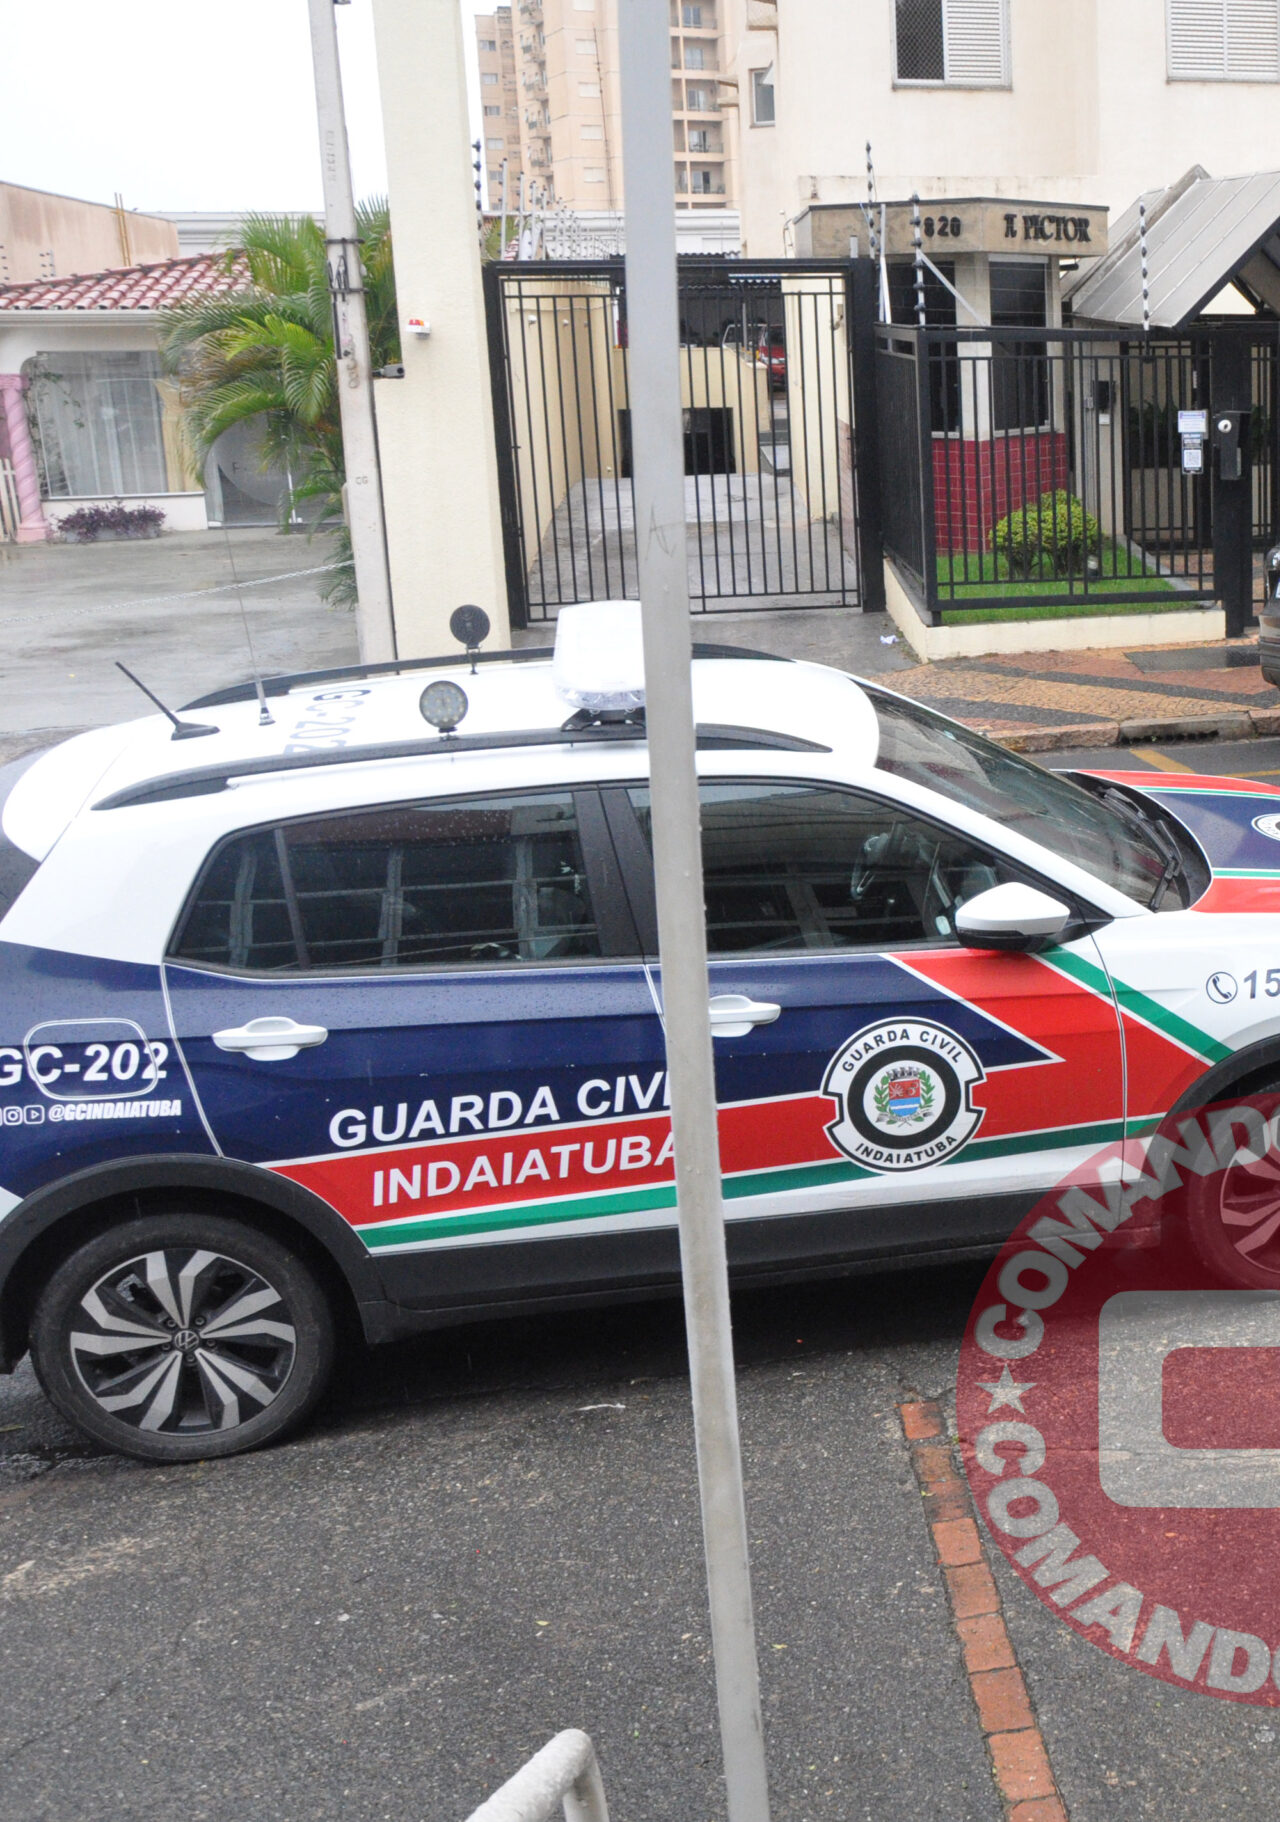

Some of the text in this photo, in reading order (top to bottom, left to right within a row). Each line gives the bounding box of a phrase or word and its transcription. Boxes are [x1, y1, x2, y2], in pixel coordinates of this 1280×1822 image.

[923, 215, 962, 238] 820
[1022, 214, 1092, 243] PICTOR
[0, 1041, 169, 1087] GC-202
[841, 1028, 964, 1073] GUARDA CIVIL
[48, 1099, 183, 1122] @GCINDAIATUBA
[328, 1085, 561, 1148] GUARDA
[854, 1134, 958, 1164] INDAIATUBA
